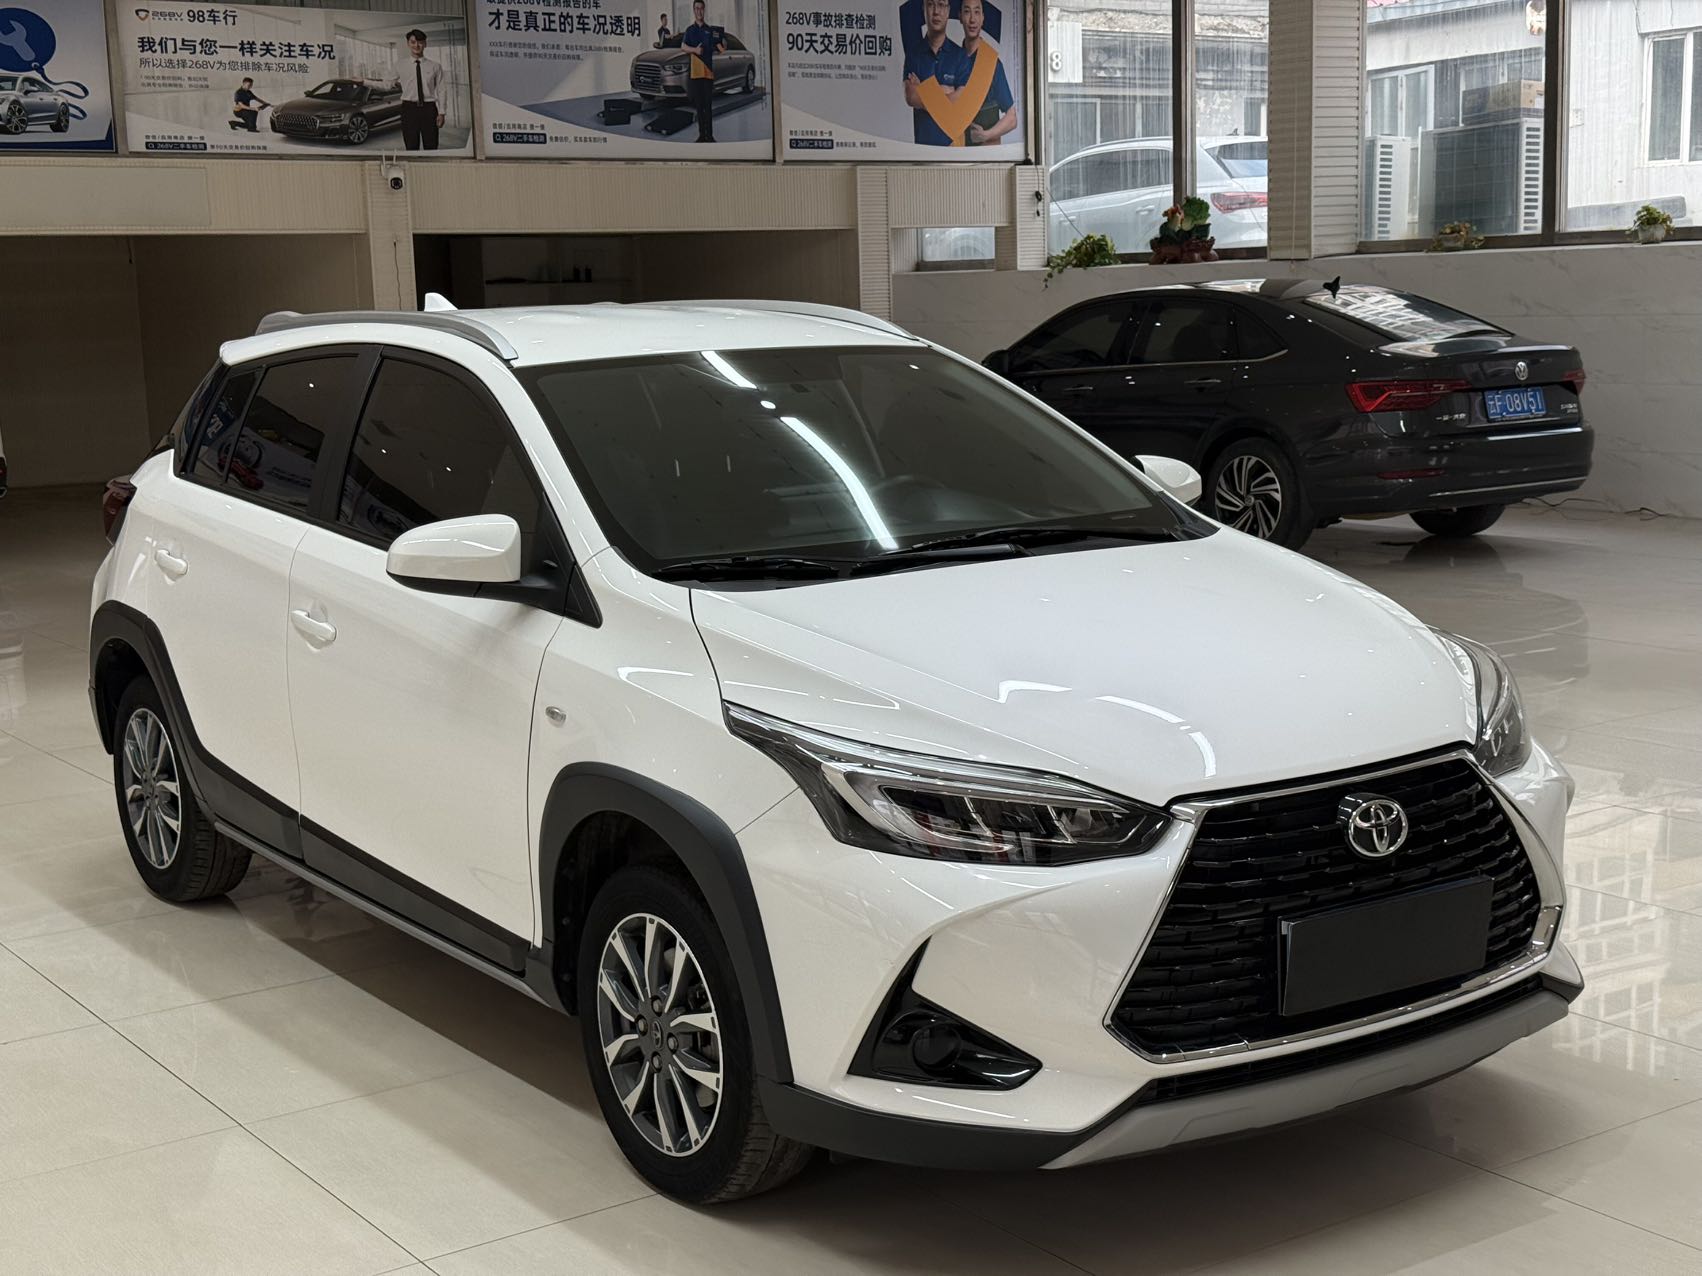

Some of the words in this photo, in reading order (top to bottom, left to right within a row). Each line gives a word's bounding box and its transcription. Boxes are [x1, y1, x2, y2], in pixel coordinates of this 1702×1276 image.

[151, 10, 183, 18] 268V
[187, 8, 238, 25] 98车行
[488, 8, 641, 37] 才是真正的车况透明
[785, 11, 876, 30] 268V事故排查检测
[138, 36, 335, 60] 我们与您一样关注车况
[787, 32, 892, 56] 90天交易价回购
[139, 57, 310, 74] 所以选择268V为您排除车况风险
[1050, 51, 1063, 72] 8
